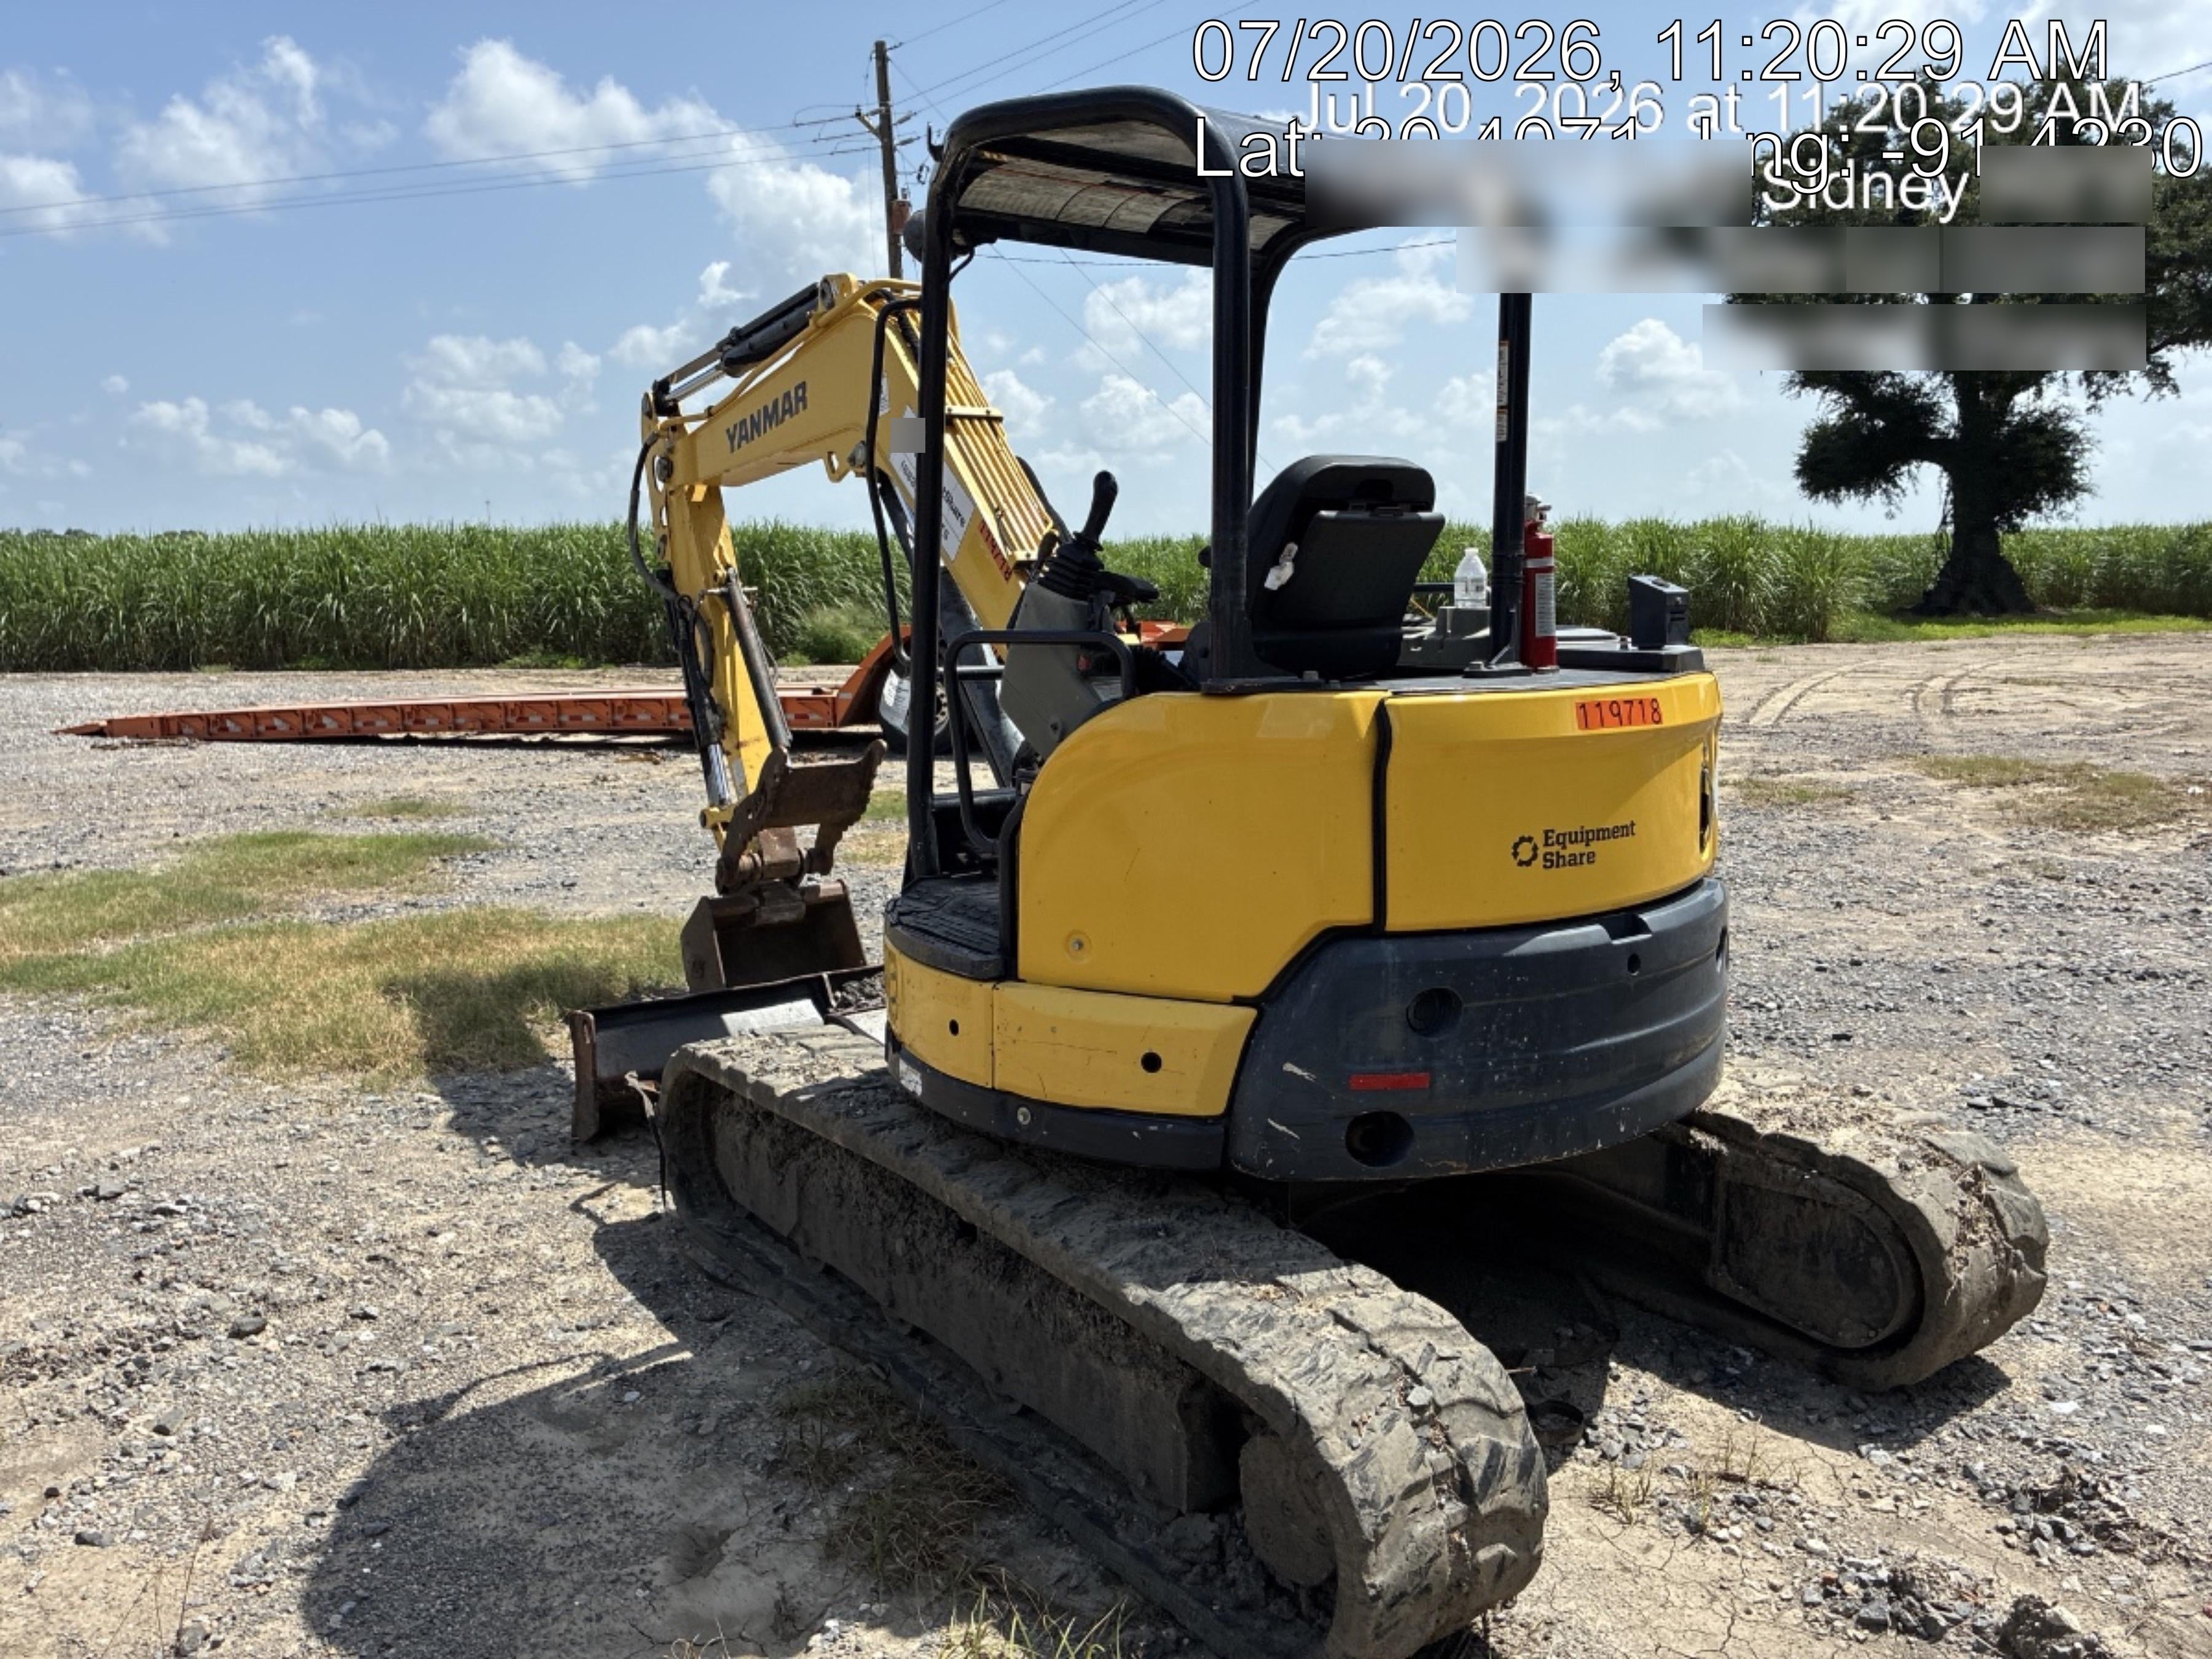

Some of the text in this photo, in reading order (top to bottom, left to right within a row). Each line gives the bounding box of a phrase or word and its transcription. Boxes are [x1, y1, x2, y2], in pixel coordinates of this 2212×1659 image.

[726, 380, 808, 454] YANMAR
[1579, 698, 1661, 729] 119718
[1542, 820, 1636, 850] Equipment
[1542, 850, 1596, 869] Share
